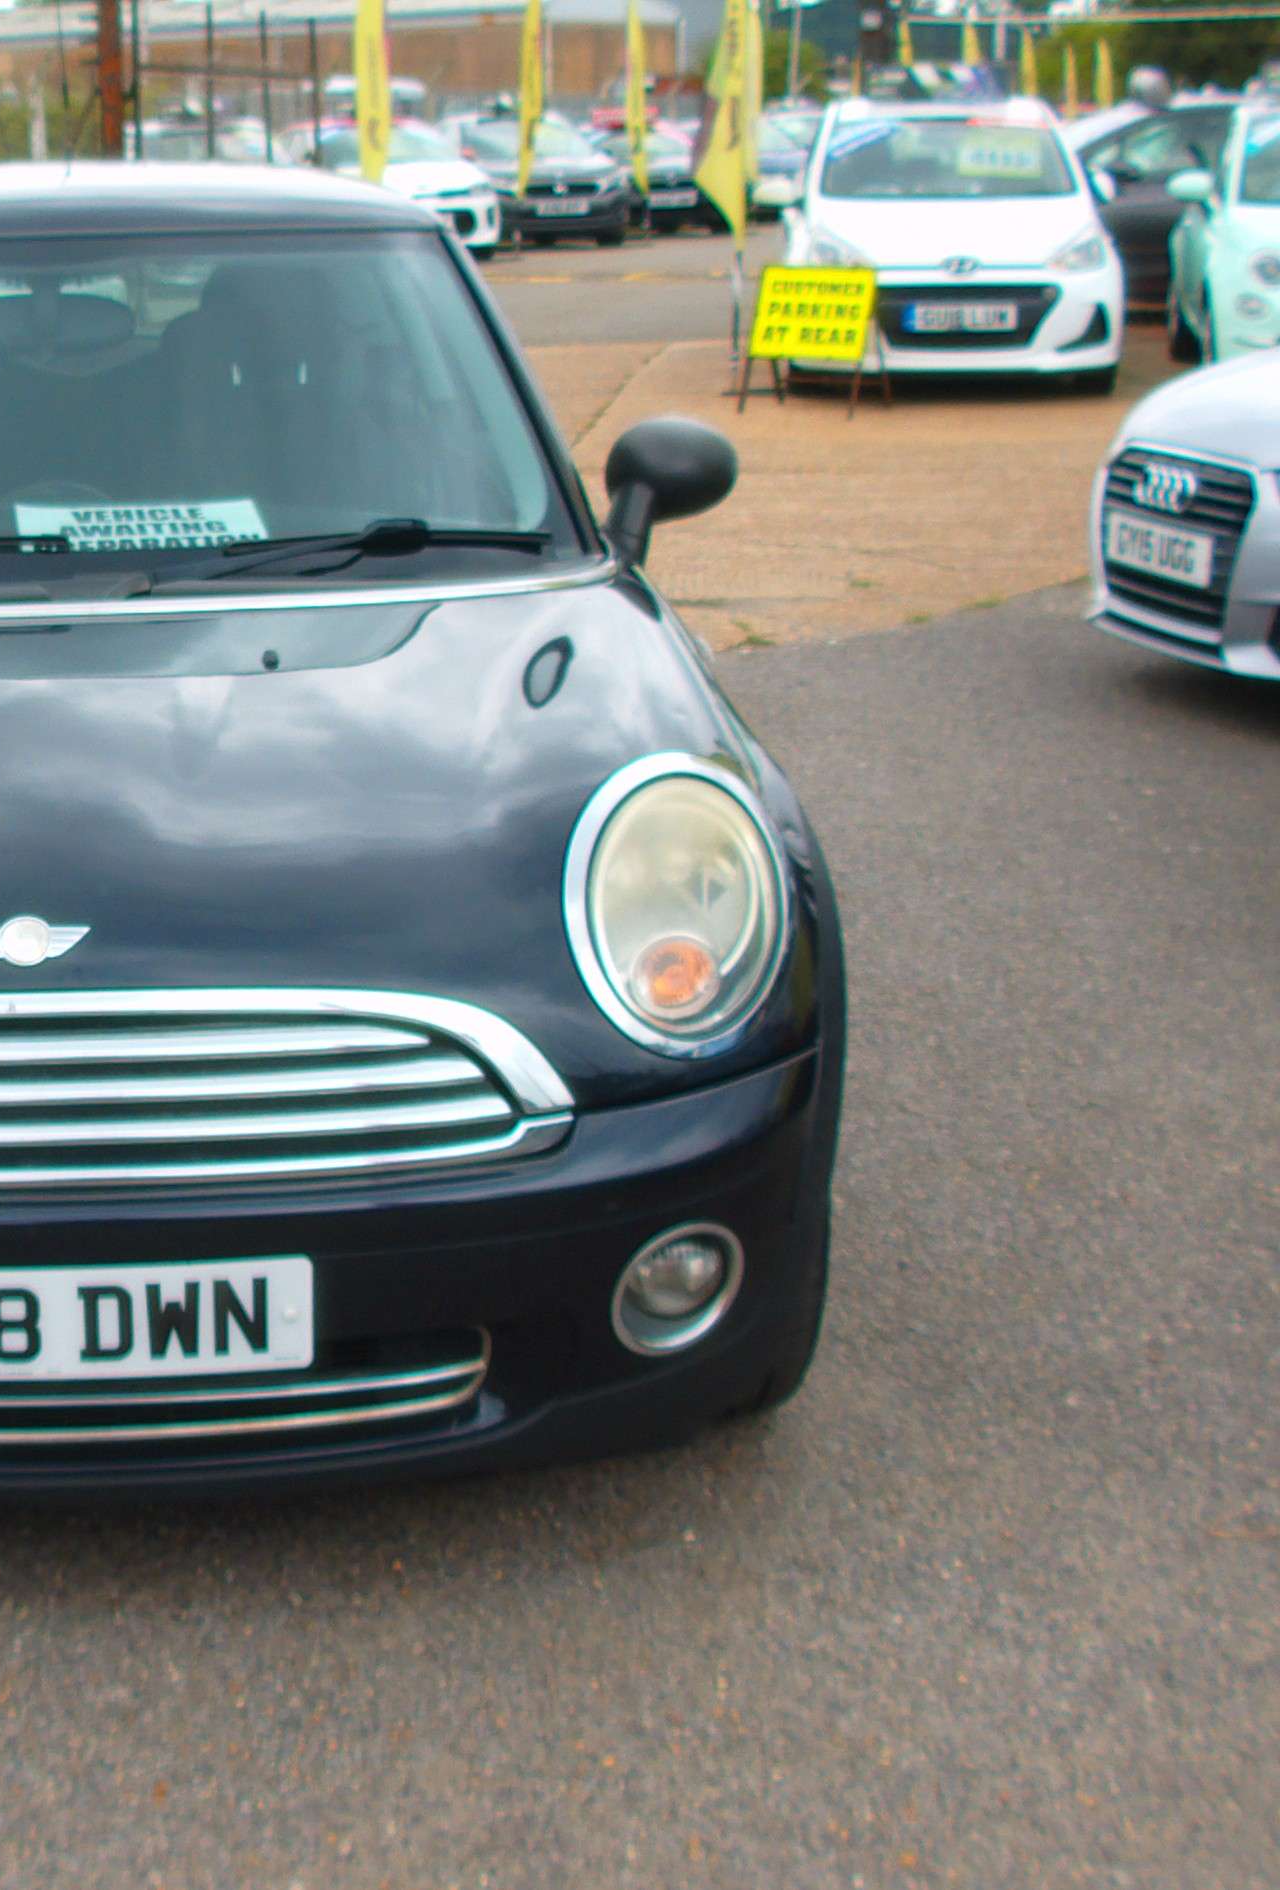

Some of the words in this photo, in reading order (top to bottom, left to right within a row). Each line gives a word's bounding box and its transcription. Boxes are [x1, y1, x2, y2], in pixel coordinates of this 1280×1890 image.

[772, 280, 865, 296] CUSTOMER
[767, 301, 861, 320] PARKING
[763, 325, 790, 343] AT
[799, 326, 858, 345] REAR
[71, 507, 206, 523] VEHICLE
[60, 521, 227, 538] AWAITING
[1118, 521, 1153, 563] GY15
[1160, 533, 1195, 575] UGG
[76, 1276, 269, 1363] DWN
